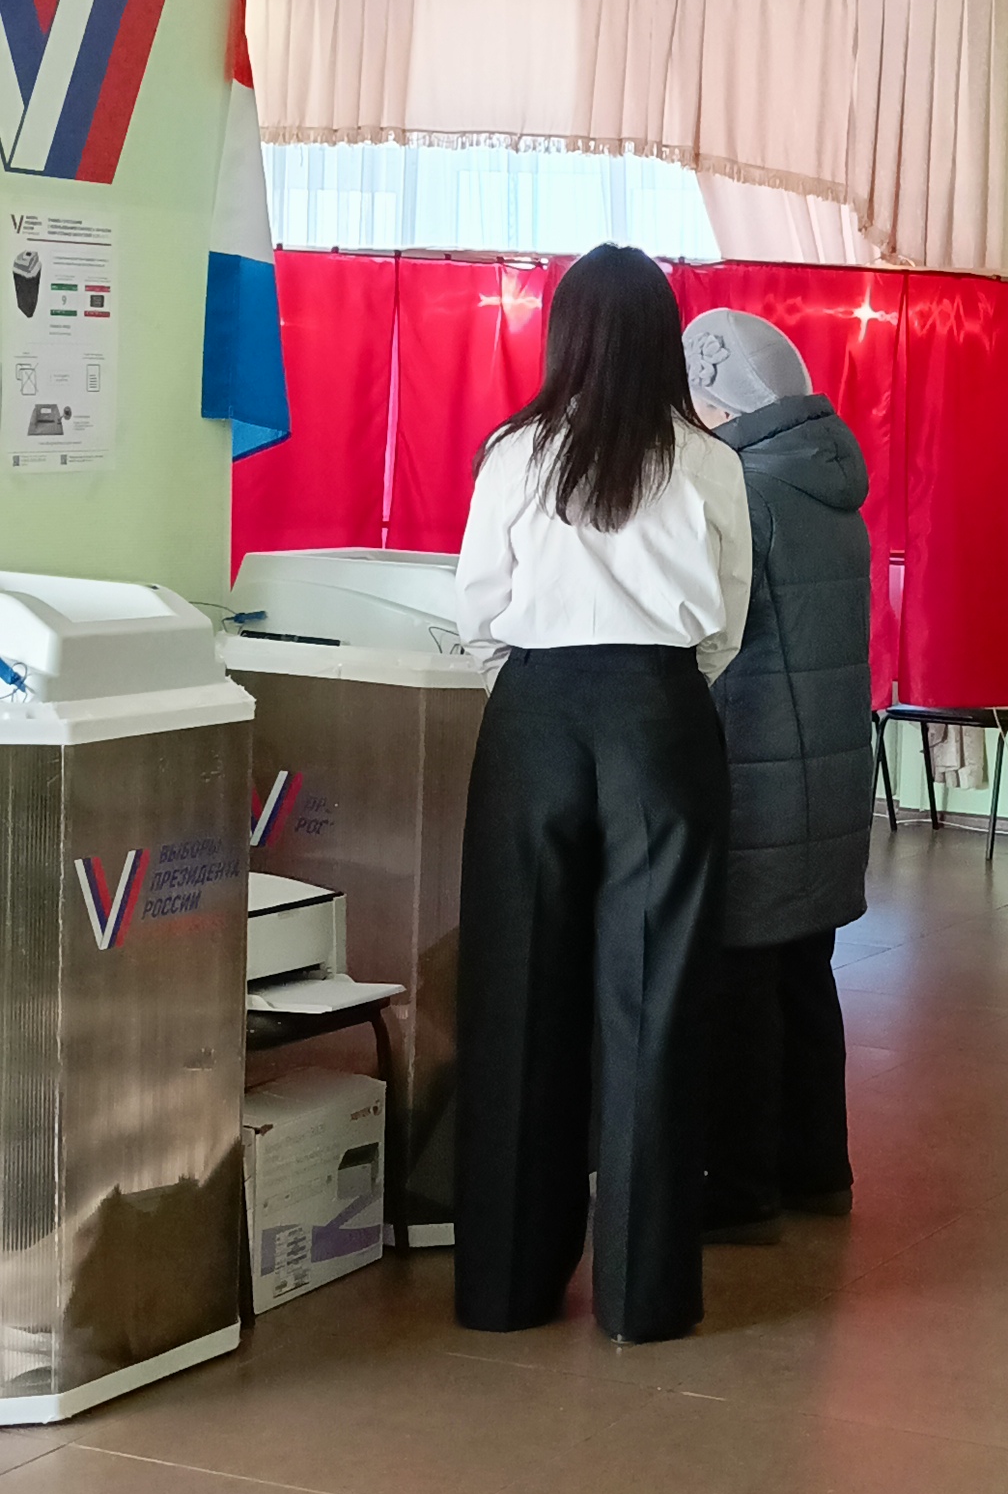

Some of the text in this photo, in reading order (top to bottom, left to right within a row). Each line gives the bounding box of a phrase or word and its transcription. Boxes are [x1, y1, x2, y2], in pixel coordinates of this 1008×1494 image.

[159, 838, 222, 864] ВЫБОРЫ
[151, 858, 240, 892] ПРЕЗИДЕНТА
[141, 890, 202, 920] РОССИИ
